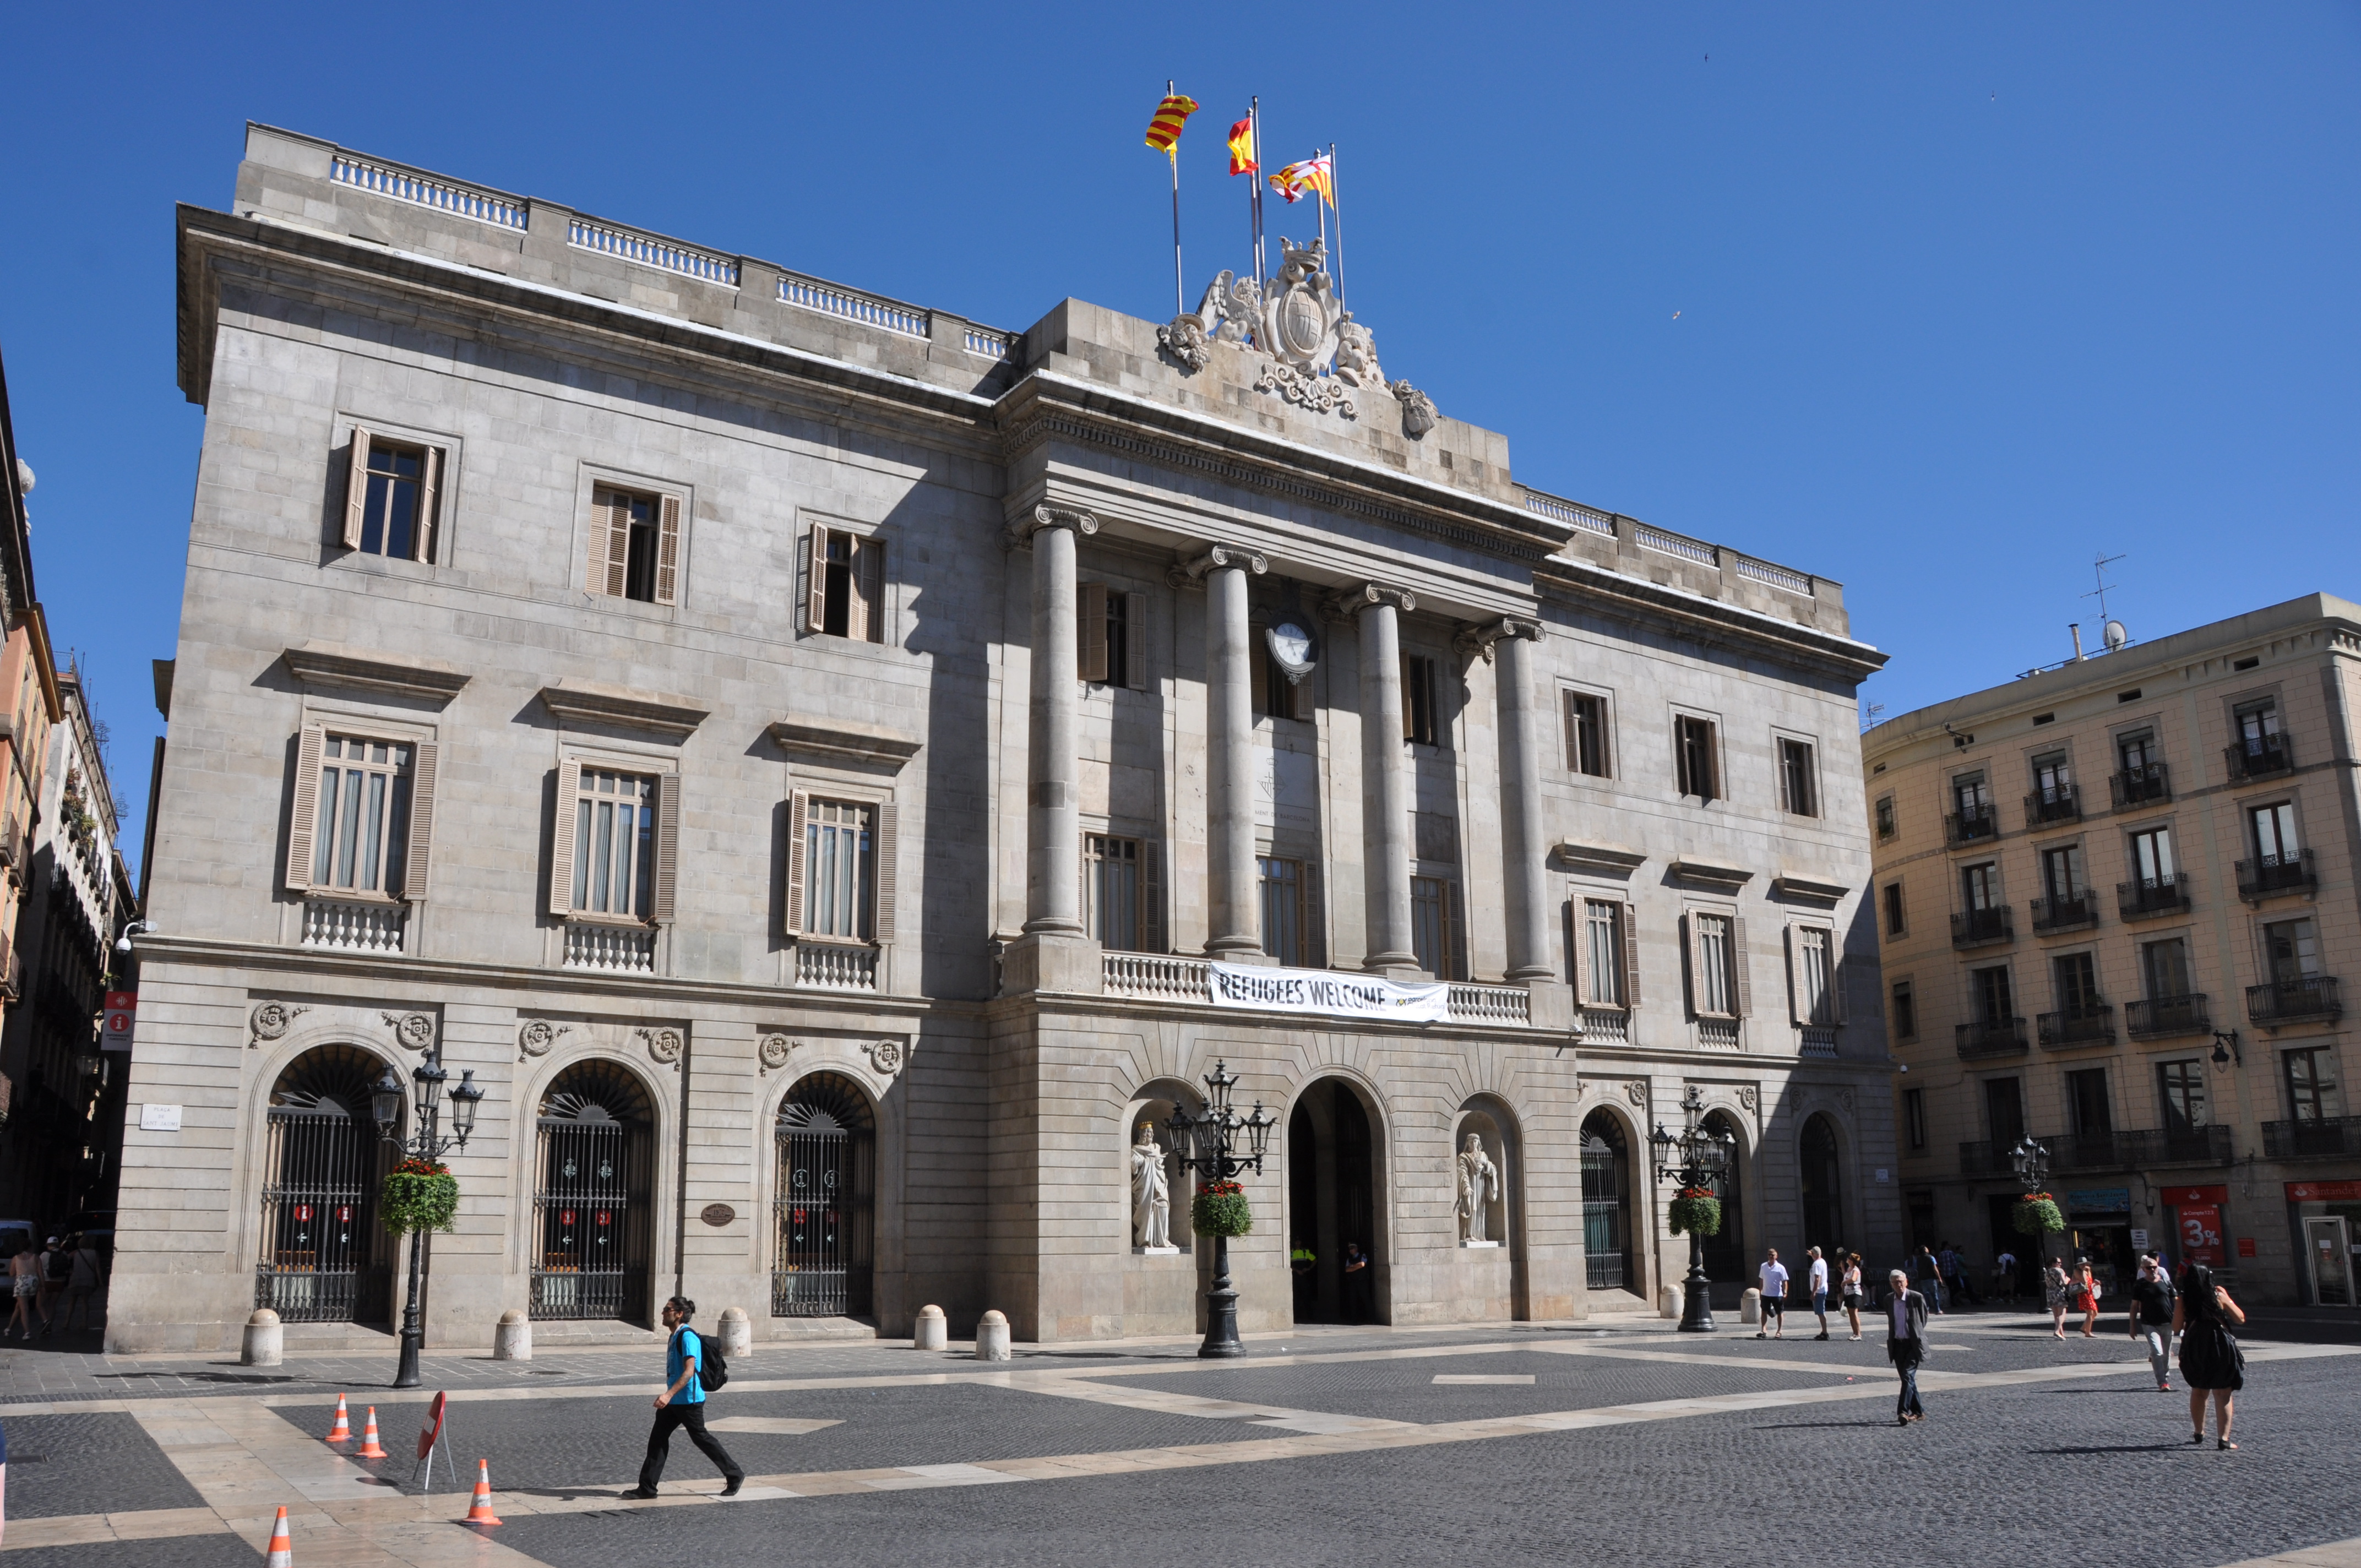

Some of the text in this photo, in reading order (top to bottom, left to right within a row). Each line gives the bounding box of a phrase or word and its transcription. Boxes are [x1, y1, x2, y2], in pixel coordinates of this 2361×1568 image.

[1219, 973, 1386, 1011] REFUGEES WELCOME
[2309, 1185, 2358, 1195] Santander
[2184, 1219, 2219, 1247] 3%
